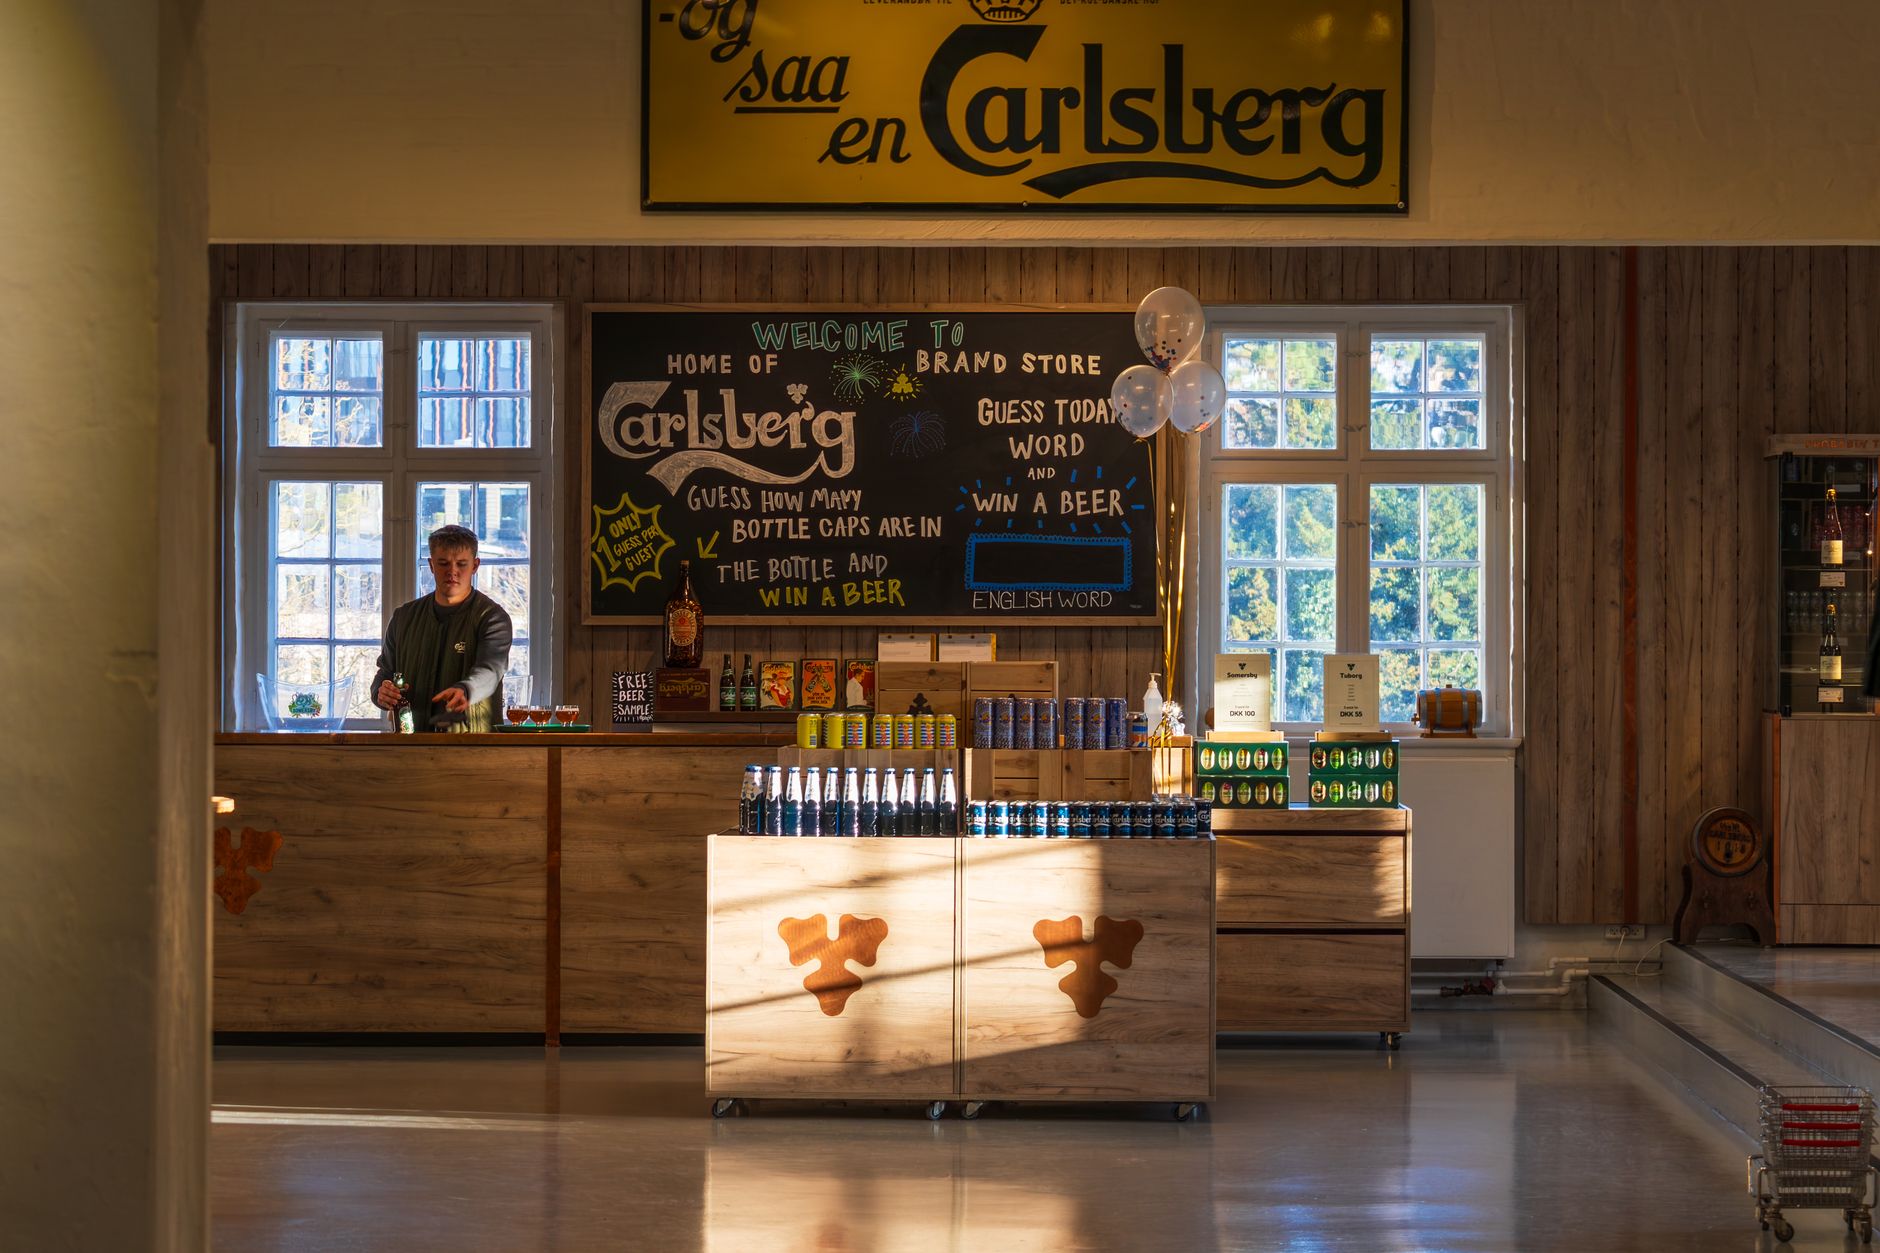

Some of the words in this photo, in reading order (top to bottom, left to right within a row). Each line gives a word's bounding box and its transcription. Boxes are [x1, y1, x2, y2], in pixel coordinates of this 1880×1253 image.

[724, 49, 852, 103] saa
[817, 115, 912, 165] en
[920, 24, 1387, 199] Carlsberg
[752, 320, 908, 352] WELCOME
[930, 320, 964, 349] TO
[667, 354, 732, 375] HOME
[748, 353, 778, 374] OF
[916, 349, 1007, 374] BRAND
[1021, 352, 1101, 375] STORE
[978, 398, 1045, 426] GUESS
[1055, 398, 1117, 425] TODAY
[598, 381, 857, 497] Carlsberg
[1008, 432, 1086, 460] WORD
[1027, 467, 1056, 480] AND
[687, 485, 752, 511] GUESS
[761, 488, 804, 513] HOW
[810, 487, 861, 511] MANY
[973, 493, 1018, 513] WIN
[1033, 491, 1048, 514] A
[1060, 488, 1124, 517] BEER
[609, 511, 641, 538] ONLY
[732, 518, 811, 543] BOTTLE
[819, 516, 870, 537] CAPS
[879, 516, 916, 538] ARE
[919, 515, 941, 537] IN
[596, 536, 622, 572] 1
[613, 535, 643, 557] GUESS
[641, 525, 660, 542] PER
[624, 542, 657, 571] GUEST
[716, 559, 760, 583] THE
[767, 556, 836, 583] BOTTLE
[848, 552, 888, 577] AND
[759, 586, 809, 608] WIN
[821, 585, 837, 607] A
[842, 579, 905, 608] BEER
[972, 591, 1053, 610] ENGLISH
[1058, 591, 1113, 608] WORD
[618, 673, 648, 689] FREE
[617, 703, 650, 716] SAMPLE
[619, 689, 646, 702] BEER
